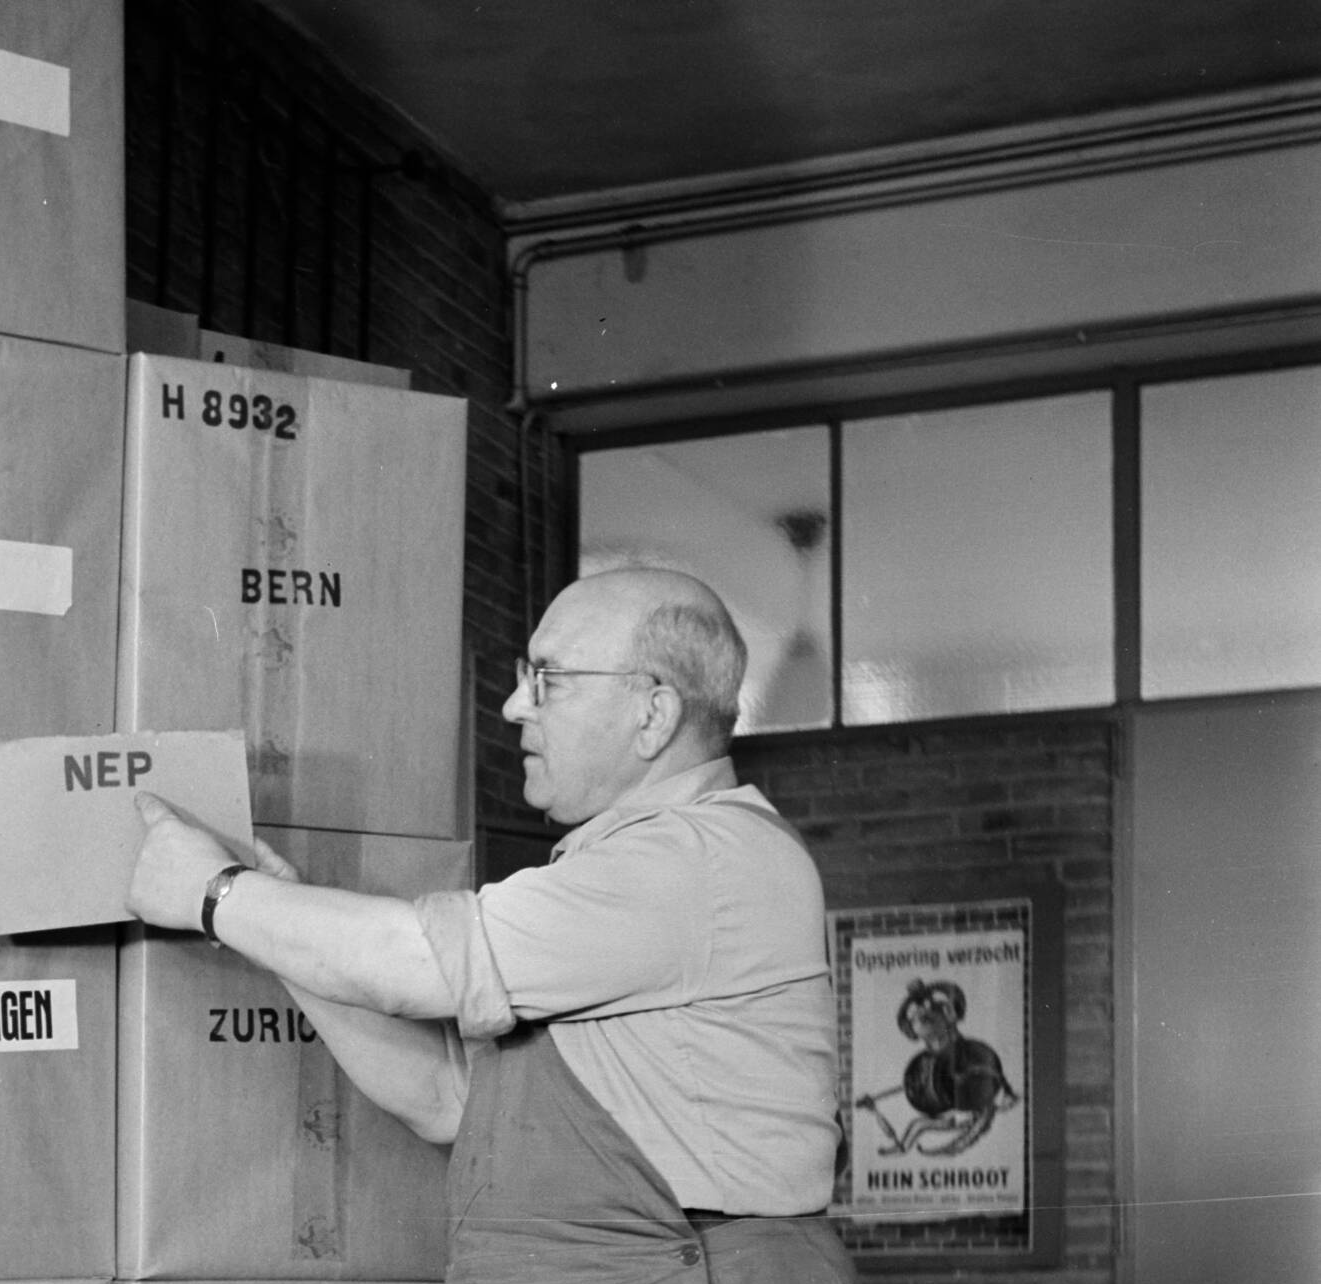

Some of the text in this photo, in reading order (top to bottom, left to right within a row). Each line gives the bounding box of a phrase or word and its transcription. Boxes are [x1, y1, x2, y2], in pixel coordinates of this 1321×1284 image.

[201, 389, 297, 440] 8932
[241, 568, 341, 607] BERN
[64, 751, 153, 792] NEP
[209, 1007, 324, 1043] ZURIC
[867, 1166, 1010, 1191] HEIN SCHROOT
